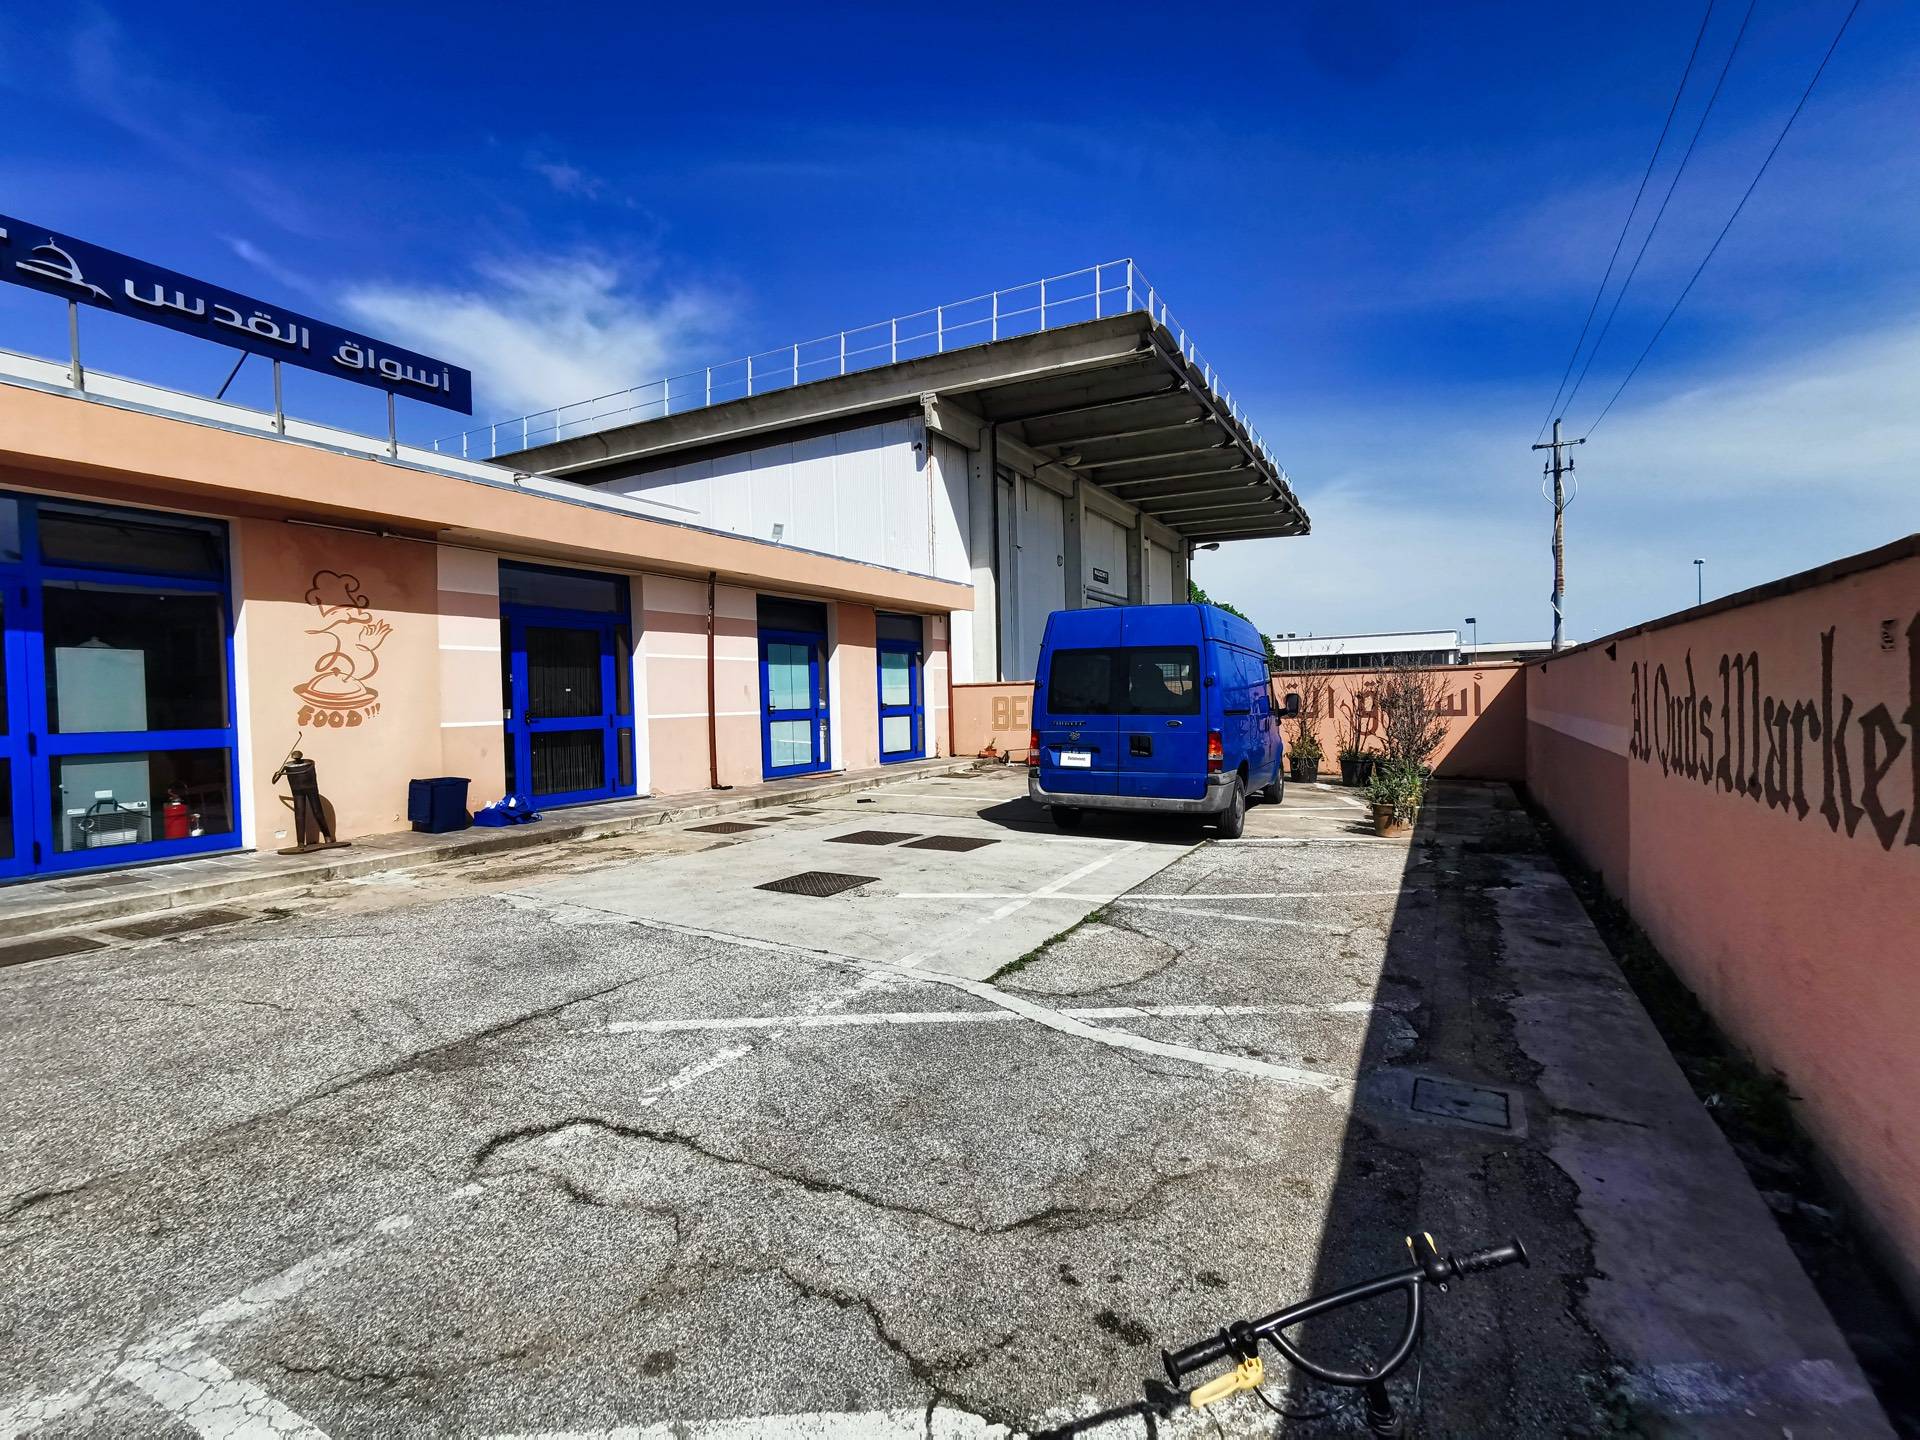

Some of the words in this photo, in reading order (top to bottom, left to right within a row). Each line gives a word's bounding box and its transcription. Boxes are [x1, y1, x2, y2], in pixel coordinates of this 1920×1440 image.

[124, 279, 309, 349] القدس
[333, 341, 450, 392] أسواق
[992, 696, 1033, 731] BE
[1352, 672, 1482, 736] أسق
[1629, 661, 1651, 764] Al
[1654, 648, 1714, 785] Quds
